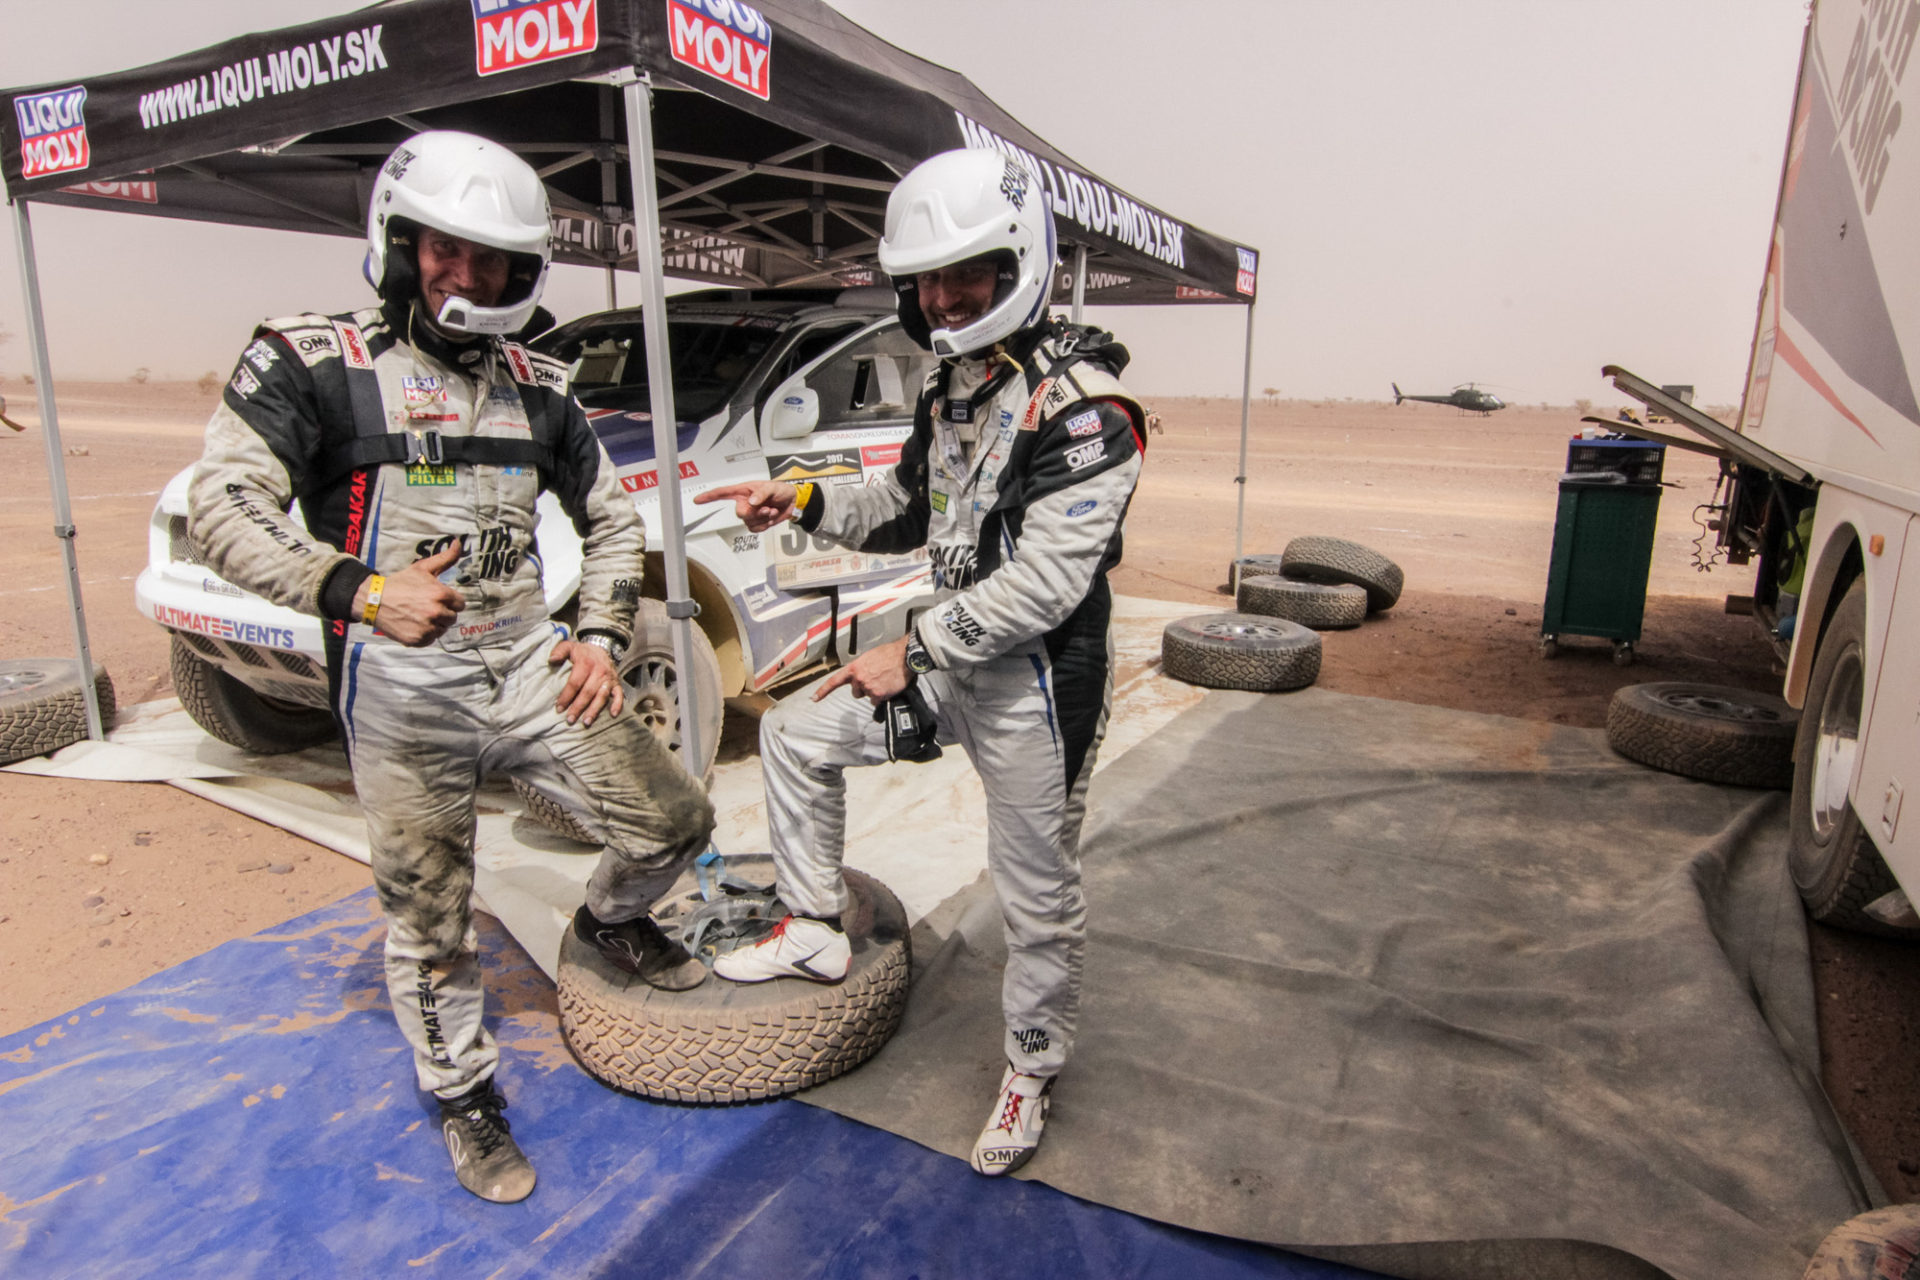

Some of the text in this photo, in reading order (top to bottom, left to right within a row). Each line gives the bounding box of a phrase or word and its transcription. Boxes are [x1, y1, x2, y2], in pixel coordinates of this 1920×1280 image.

[482, 0, 592, 68] MOLY
[674, 8, 768, 90] MOLY
[139, 24, 388, 129] WWW.LIQUI-MOLY.SK
[18, 91, 83, 136] LIQUI
[25, 129, 84, 174] MOLY
[300, 336, 332, 352] OMP
[534, 369, 563, 384] OMP
[1024, 382, 1048, 426] SIMPSON
[1069, 412, 1097, 430] LIQUI
[1071, 421, 1101, 437] MOLY
[826, 453, 844, 464] 2017
[1067, 442, 1105, 468] OMP
[409, 475, 455, 485] FILTER
[952, 601, 987, 637] SOUTH
[1012, 1028, 1046, 1042] OUTH
[1021, 1038, 1050, 1054] CING
